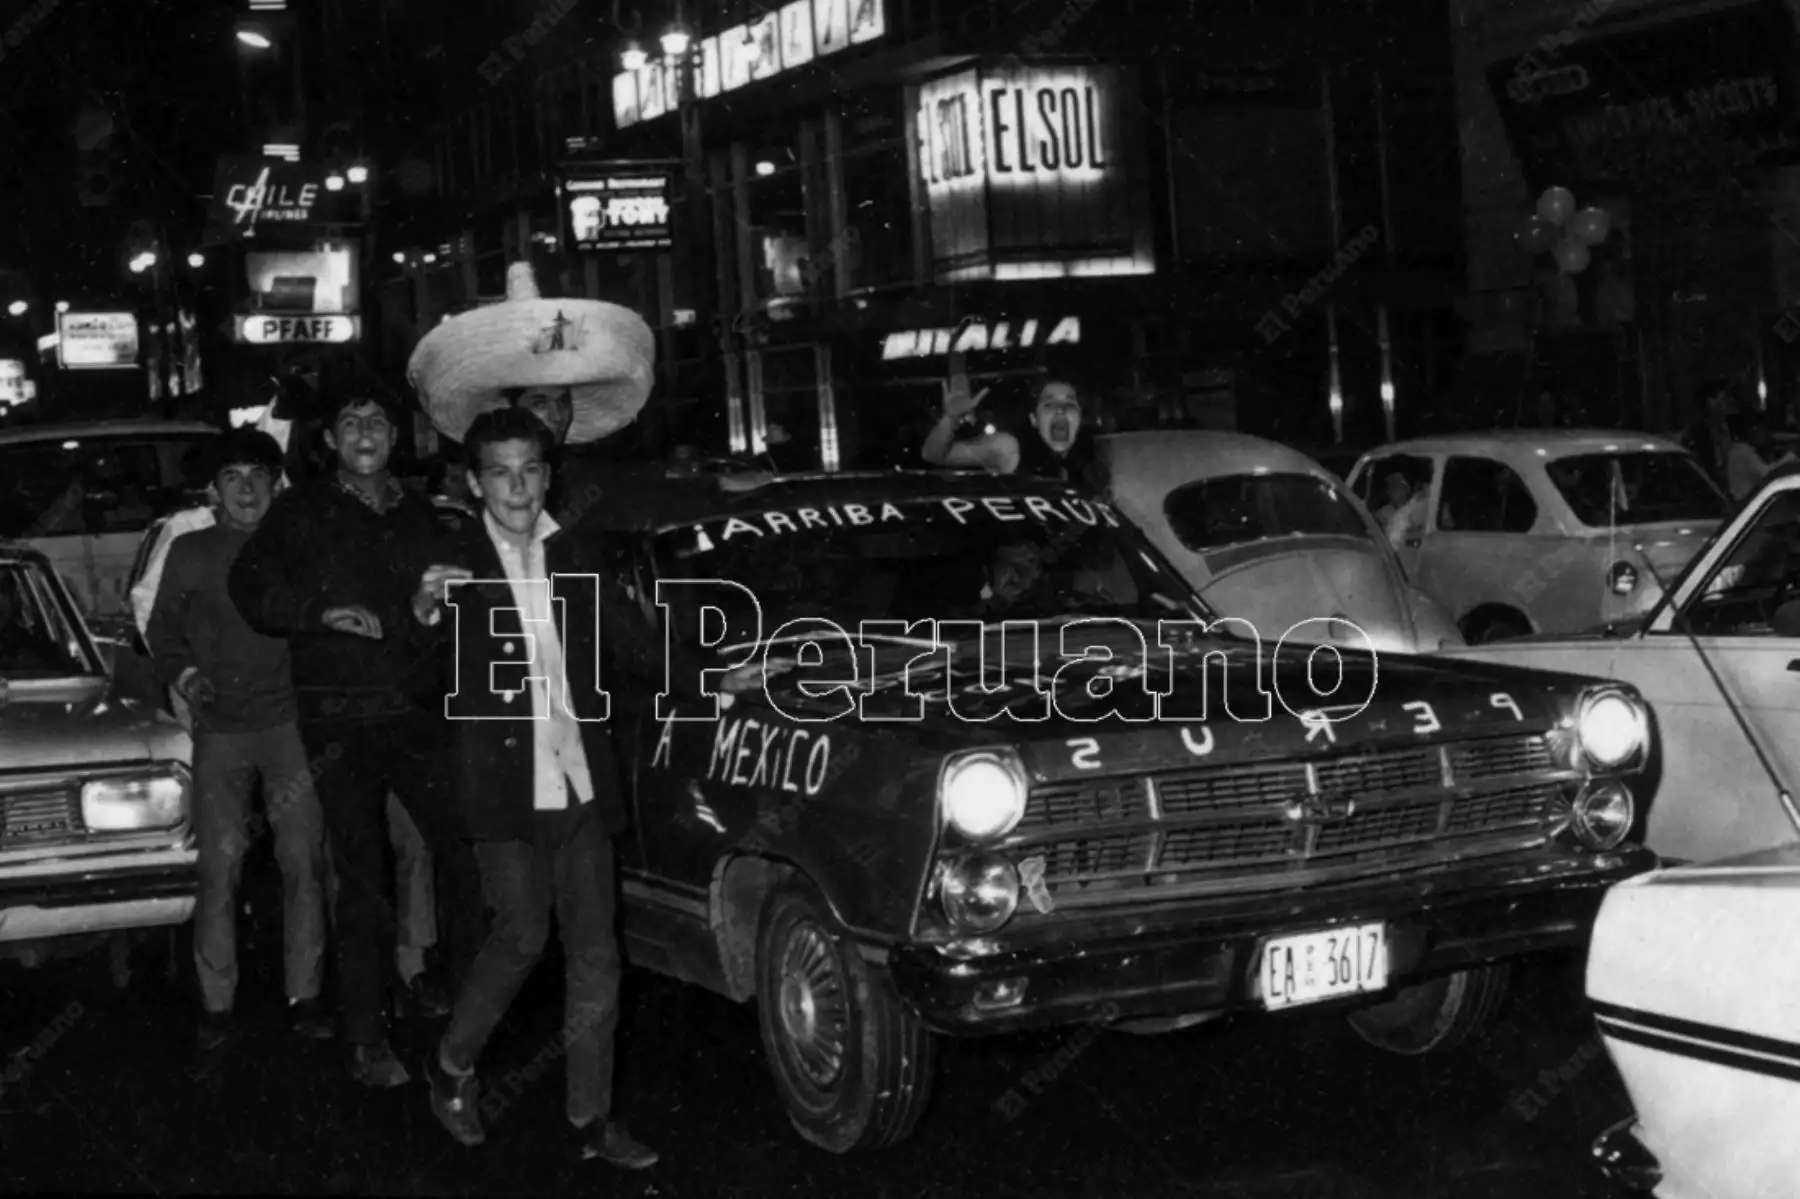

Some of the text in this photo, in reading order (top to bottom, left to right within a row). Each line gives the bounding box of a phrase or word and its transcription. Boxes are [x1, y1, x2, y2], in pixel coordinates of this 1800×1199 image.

[262, 319, 336, 339] PFAFF
[694, 503, 905, 551] ¡ARRIBA
[652, 708, 677, 768] A
[1269, 946, 1296, 998] EA
[1326, 932, 1379, 987] 3617
